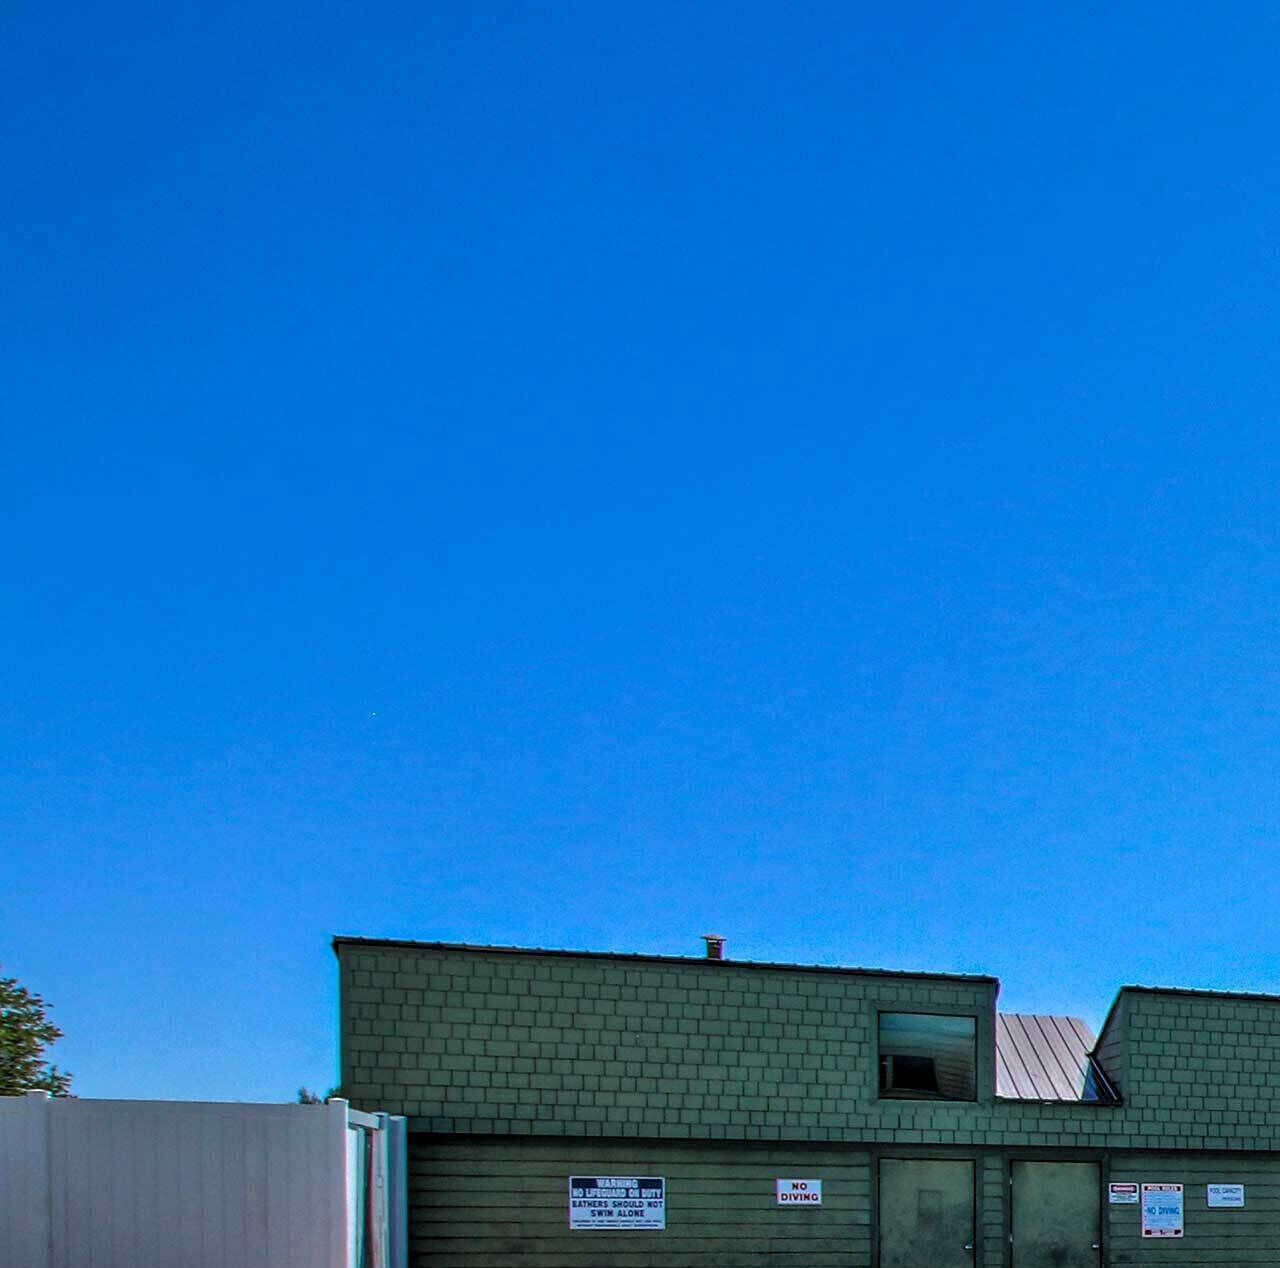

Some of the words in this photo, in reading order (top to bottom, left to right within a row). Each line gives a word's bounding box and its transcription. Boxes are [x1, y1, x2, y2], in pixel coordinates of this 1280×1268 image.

[596, 1179, 639, 1188] WARNING
[792, 1182, 807, 1190] NO
[572, 1188, 584, 1198] NO
[585, 1188, 627, 1198] LIFEGUARD
[628, 1188, 640, 1198] ON
[641, 1188, 662, 1197] DUTY
[781, 1193, 819, 1201] DIVING
[572, 1200, 609, 1208] BATHERS
[612, 1200, 644, 1208] SHOULD
[647, 1200, 663, 1208] NOT
[590, 1209, 614, 1217] SWIM
[617, 1209, 645, 1217] ALONE
[1147, 1206, 1157, 1214] NO
[1158, 1206, 1180, 1214] DIVING
